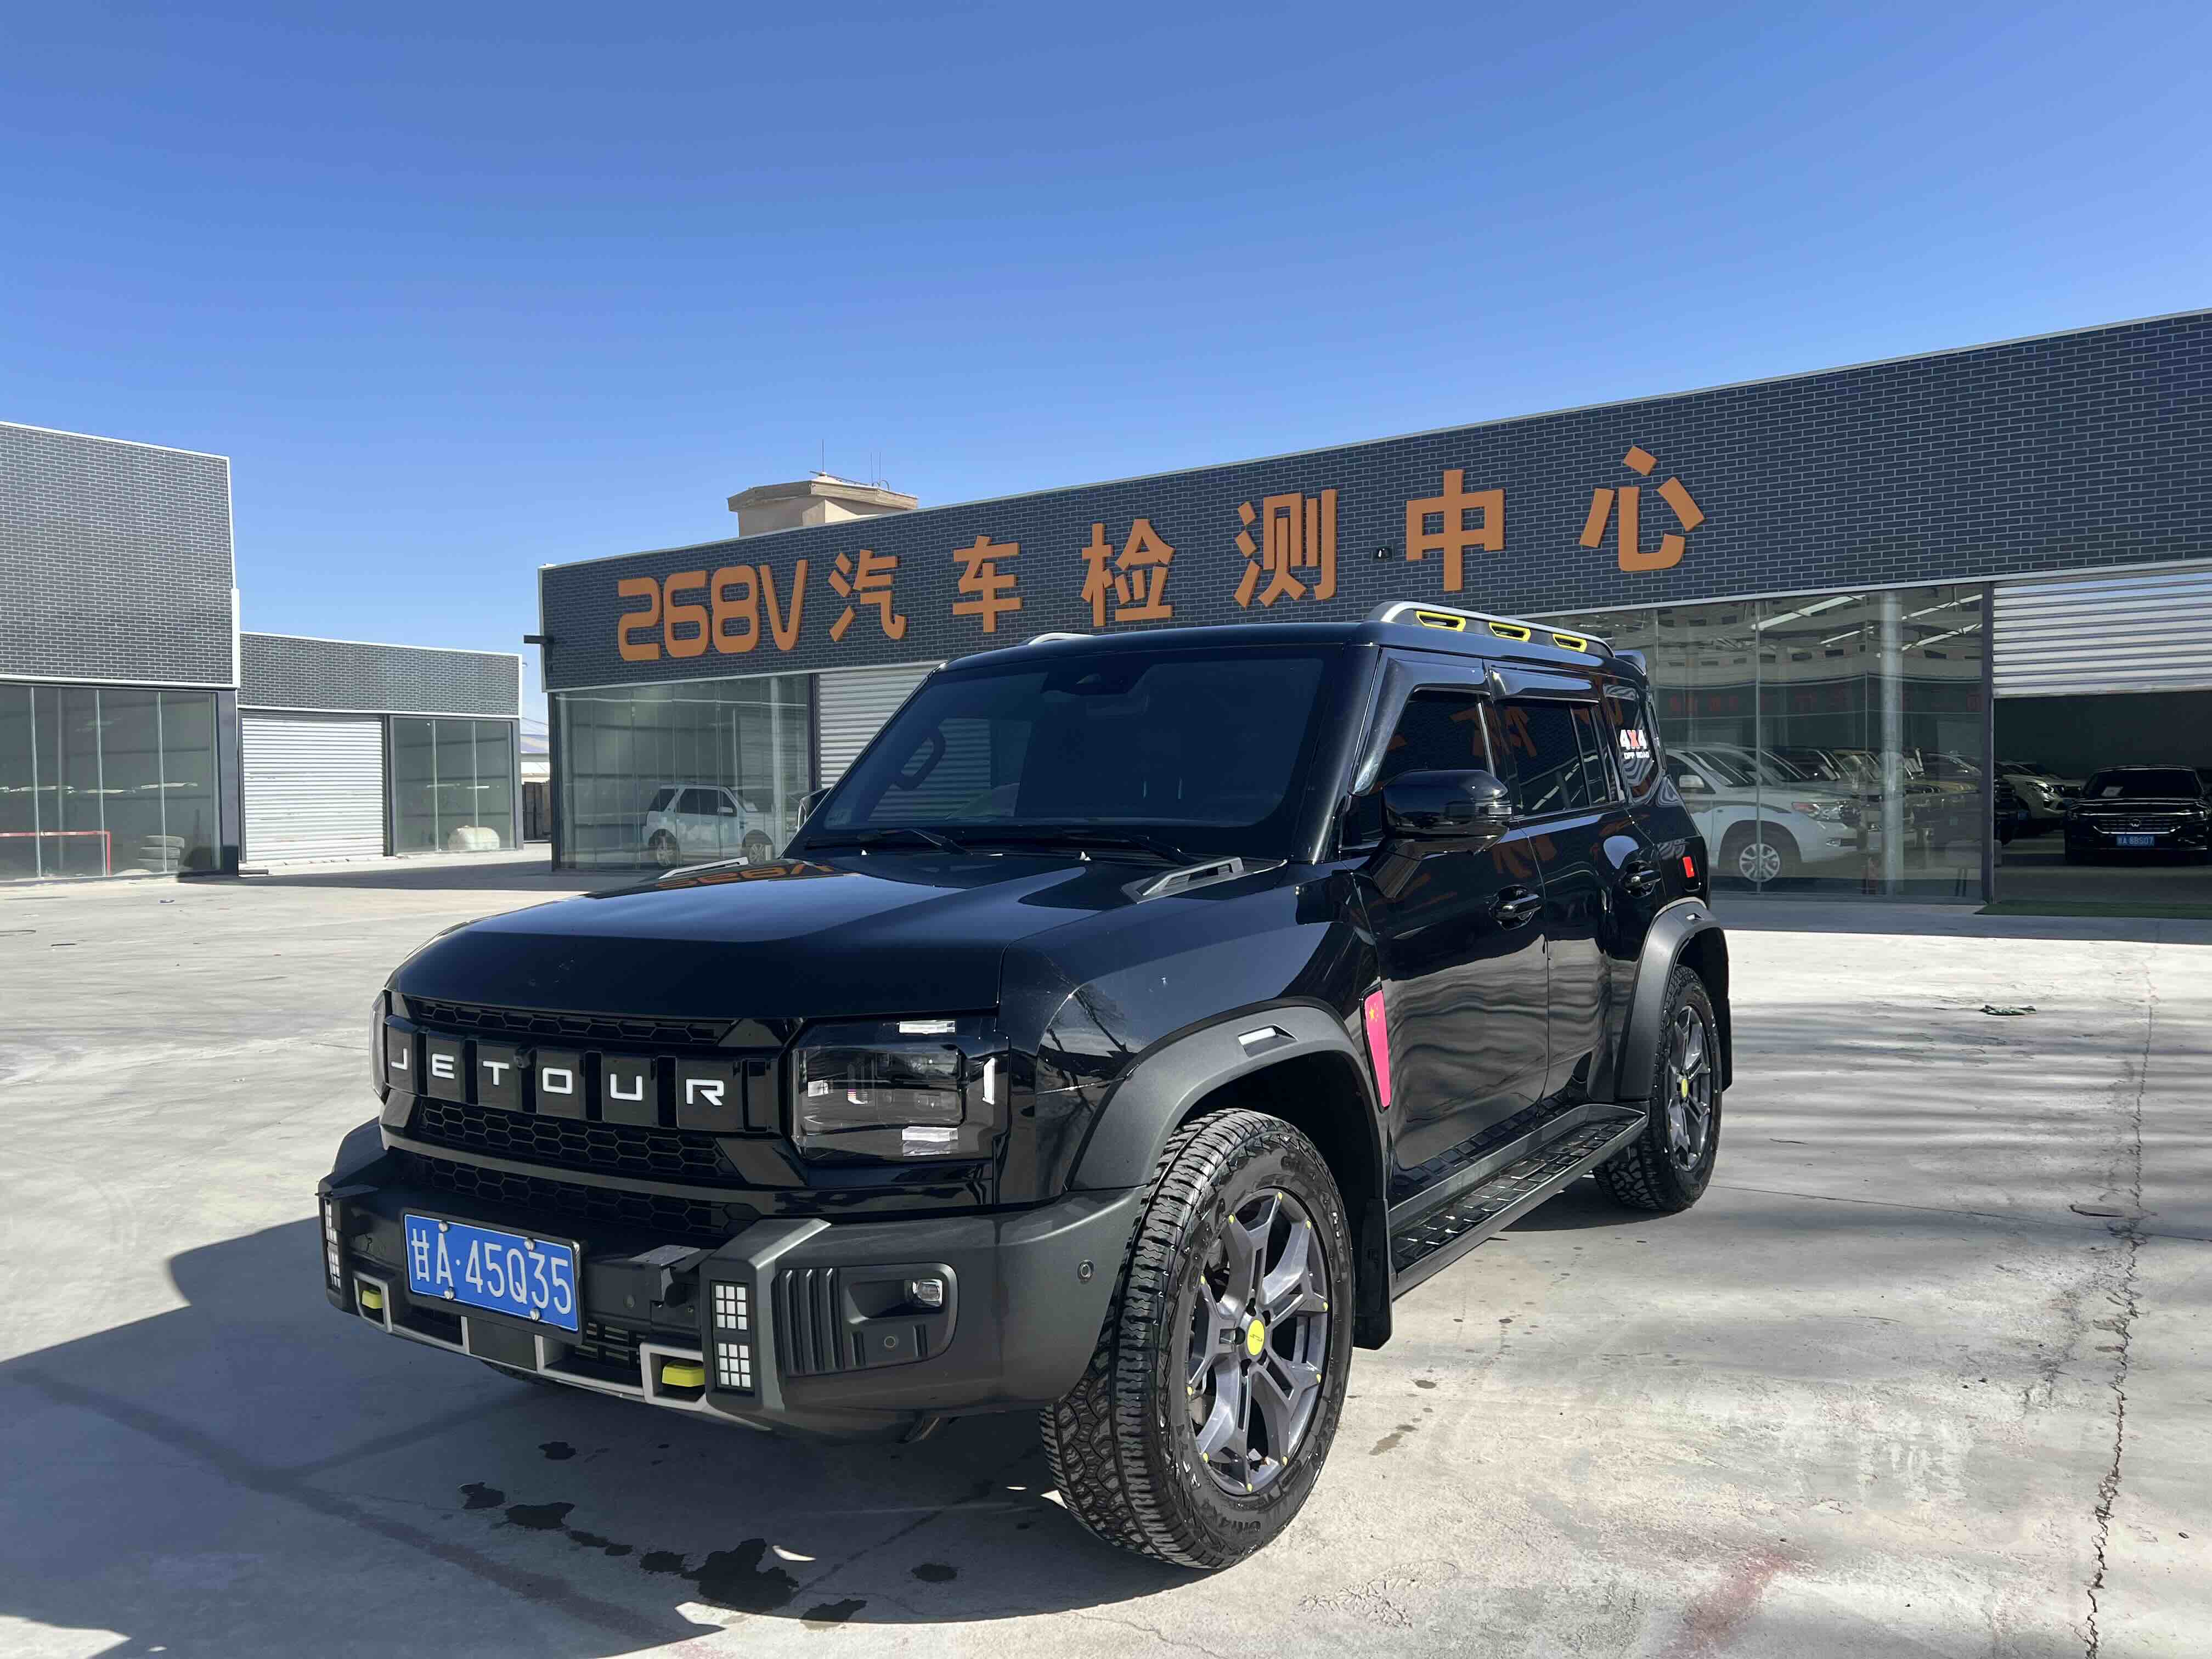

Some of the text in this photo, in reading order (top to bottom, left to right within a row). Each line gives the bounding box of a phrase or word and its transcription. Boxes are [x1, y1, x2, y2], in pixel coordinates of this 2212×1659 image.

[618, 445, 1706, 662] 268V 汽车检测中心
[391, 1048, 725, 1106] JETOUR
